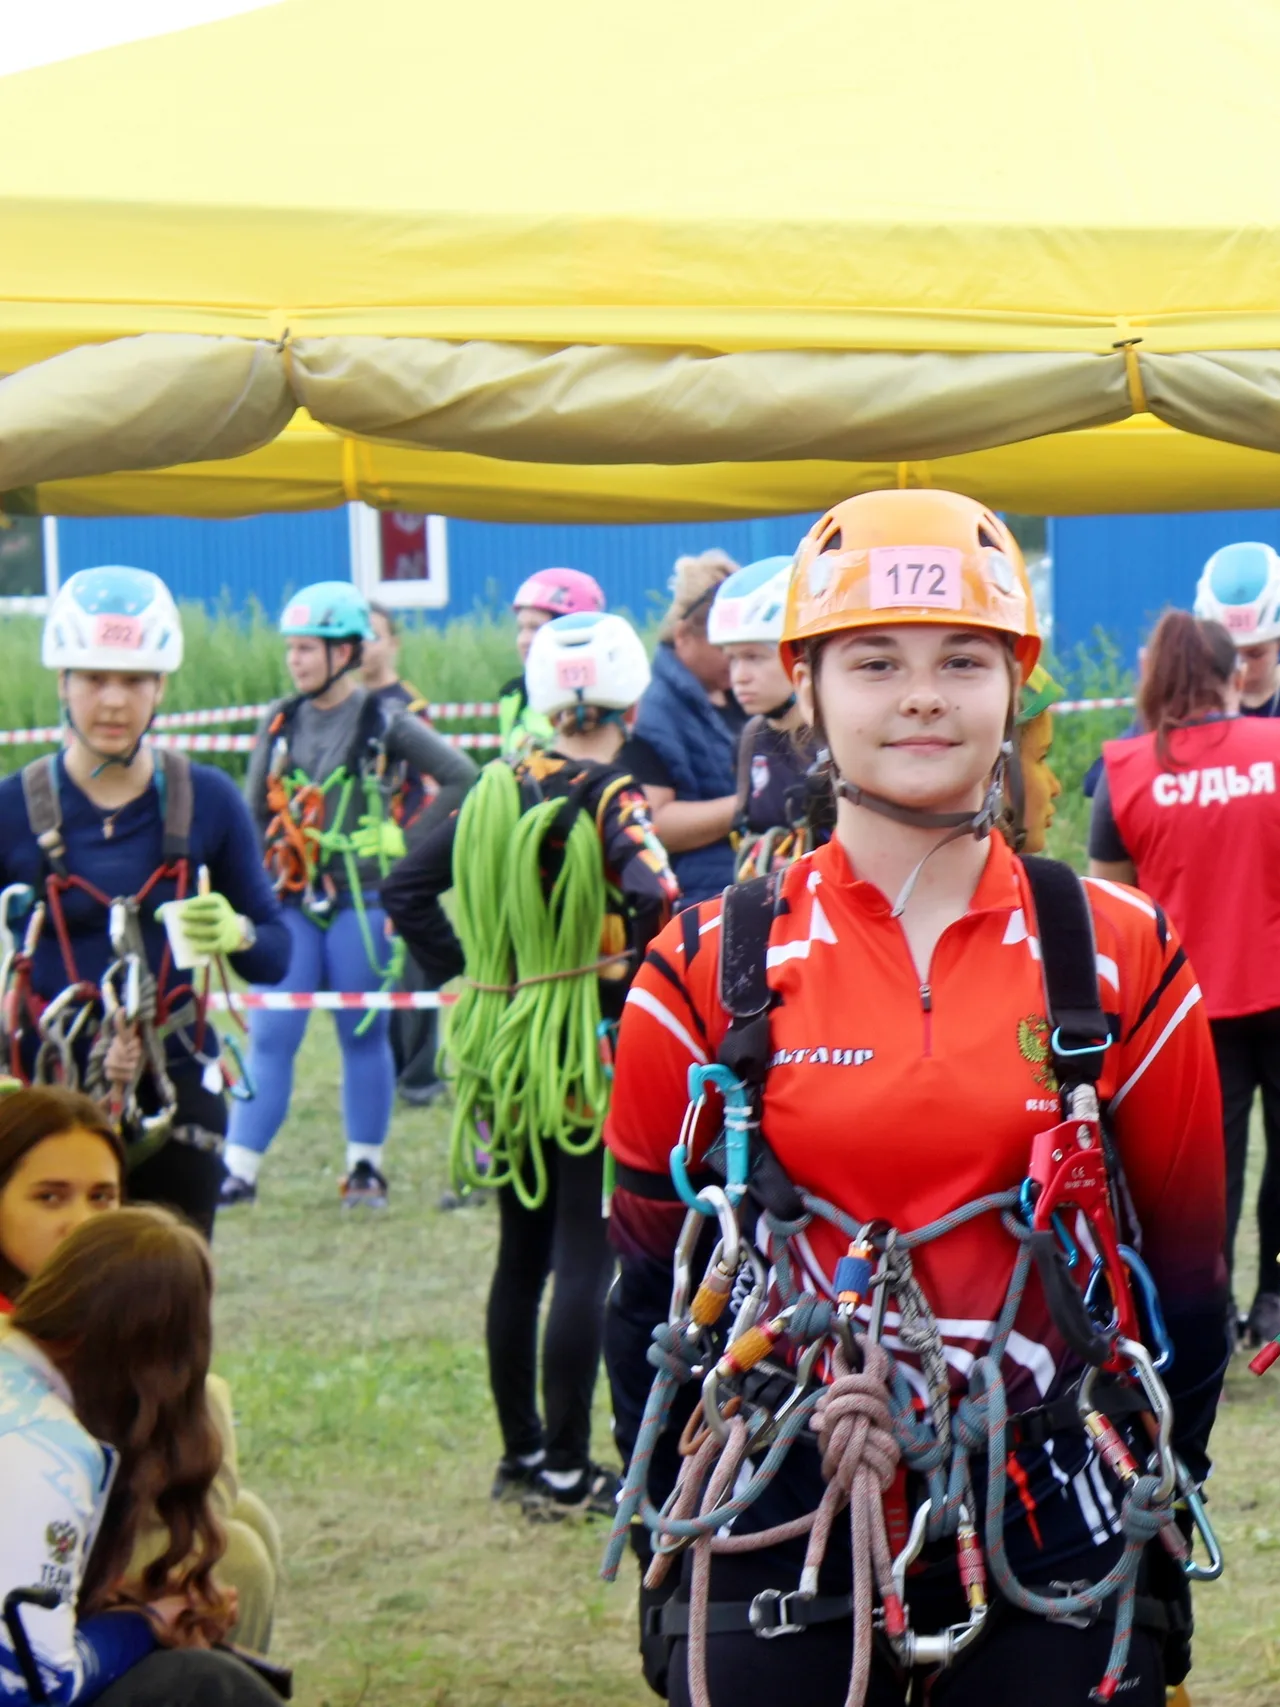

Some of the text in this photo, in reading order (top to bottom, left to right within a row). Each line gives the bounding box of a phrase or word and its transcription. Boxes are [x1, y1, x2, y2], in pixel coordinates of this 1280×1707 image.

[886, 563, 947, 596] 172
[101, 620, 133, 644] 202
[1152, 761, 1277, 808] СУДЬЯ
